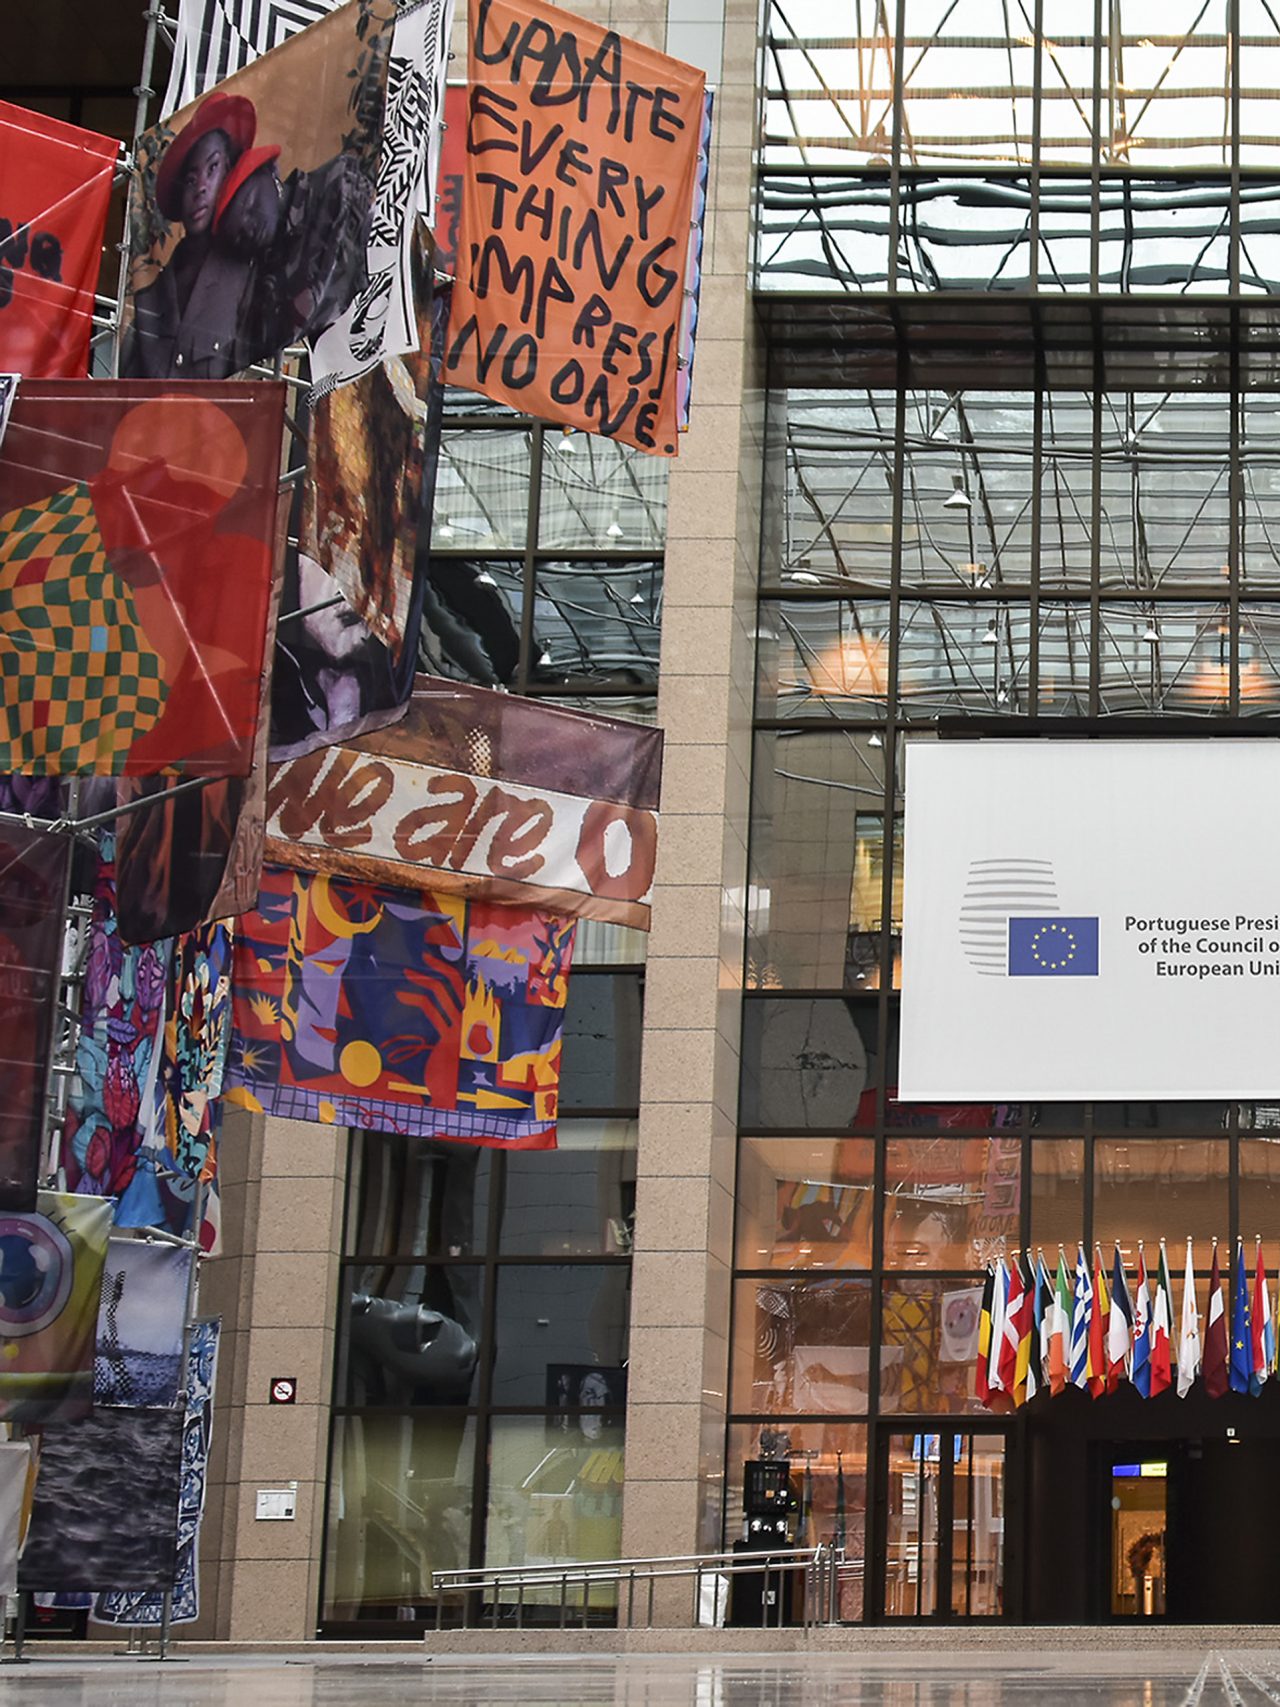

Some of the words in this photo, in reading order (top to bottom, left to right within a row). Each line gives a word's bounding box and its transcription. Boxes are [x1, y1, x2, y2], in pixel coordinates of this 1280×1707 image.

[474, 0, 685, 143] UPDATE
[467, 85, 665, 240] EVERY
[476, 173, 677, 308] THING
[447, 314, 538, 390] NO
[551, 358, 674, 454] ONE.
[392, 774, 555, 880] are
[1125, 916, 1230, 935] Portuguese
[1138, 937, 1157, 953] of
[1161, 938, 1192, 953] the
[1196, 937, 1264, 953] Council
[1156, 961, 1244, 979] European
